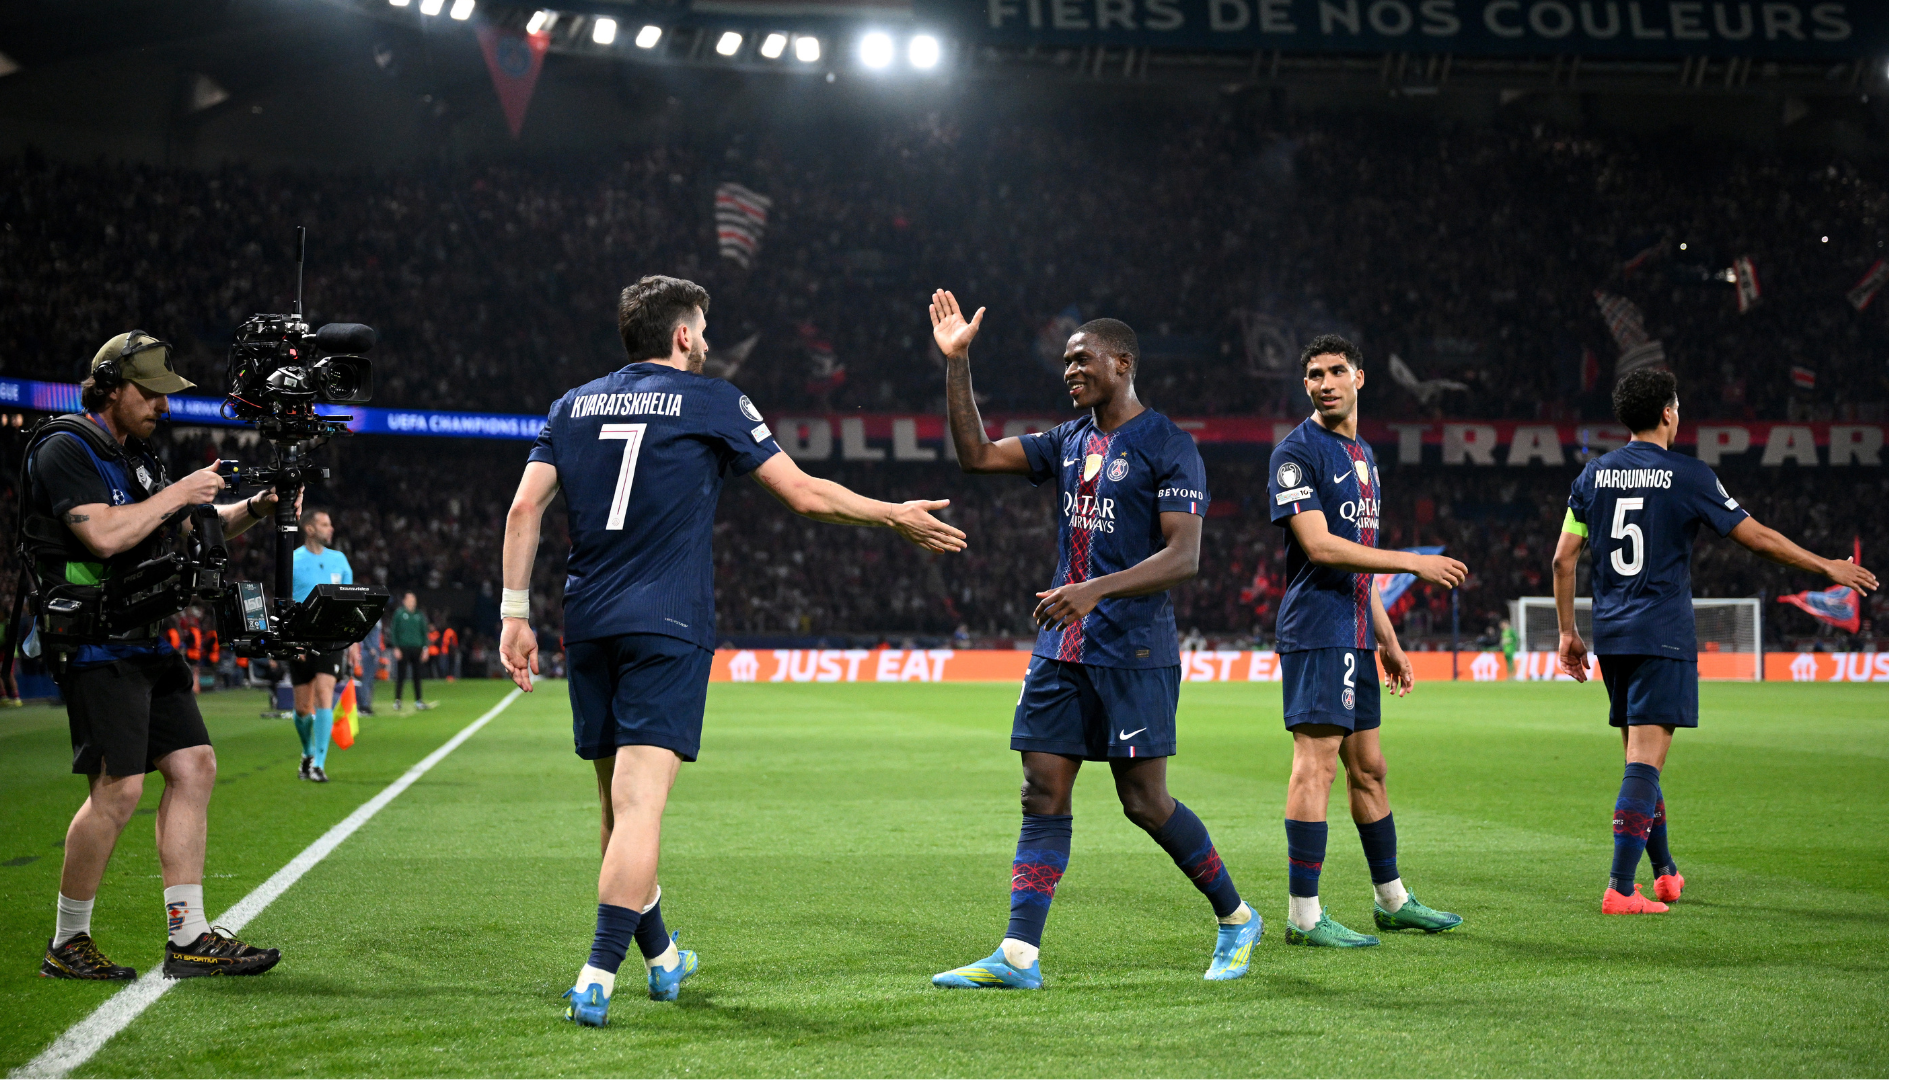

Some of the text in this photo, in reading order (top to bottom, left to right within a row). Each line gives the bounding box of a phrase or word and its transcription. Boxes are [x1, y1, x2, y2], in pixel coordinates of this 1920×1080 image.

[990, 0, 1853, 40] FIERS DE NOS COULEURS
[570, 392, 683, 418] KVARATSKHELIA
[387, 412, 427, 432] UEFA
[428, 414, 518, 434] CHAMPIONS
[598, 422, 648, 531] 7
[1594, 468, 1673, 490] MARQUINHOS
[1063, 491, 1116, 520] QATAR
[1157, 487, 1204, 501] BEYOND
[1068, 515, 1115, 534] AIRWAYS
[1610, 497, 1644, 577] 5
[770, 651, 954, 681] JUST EAT
[1343, 652, 1356, 688] 2
